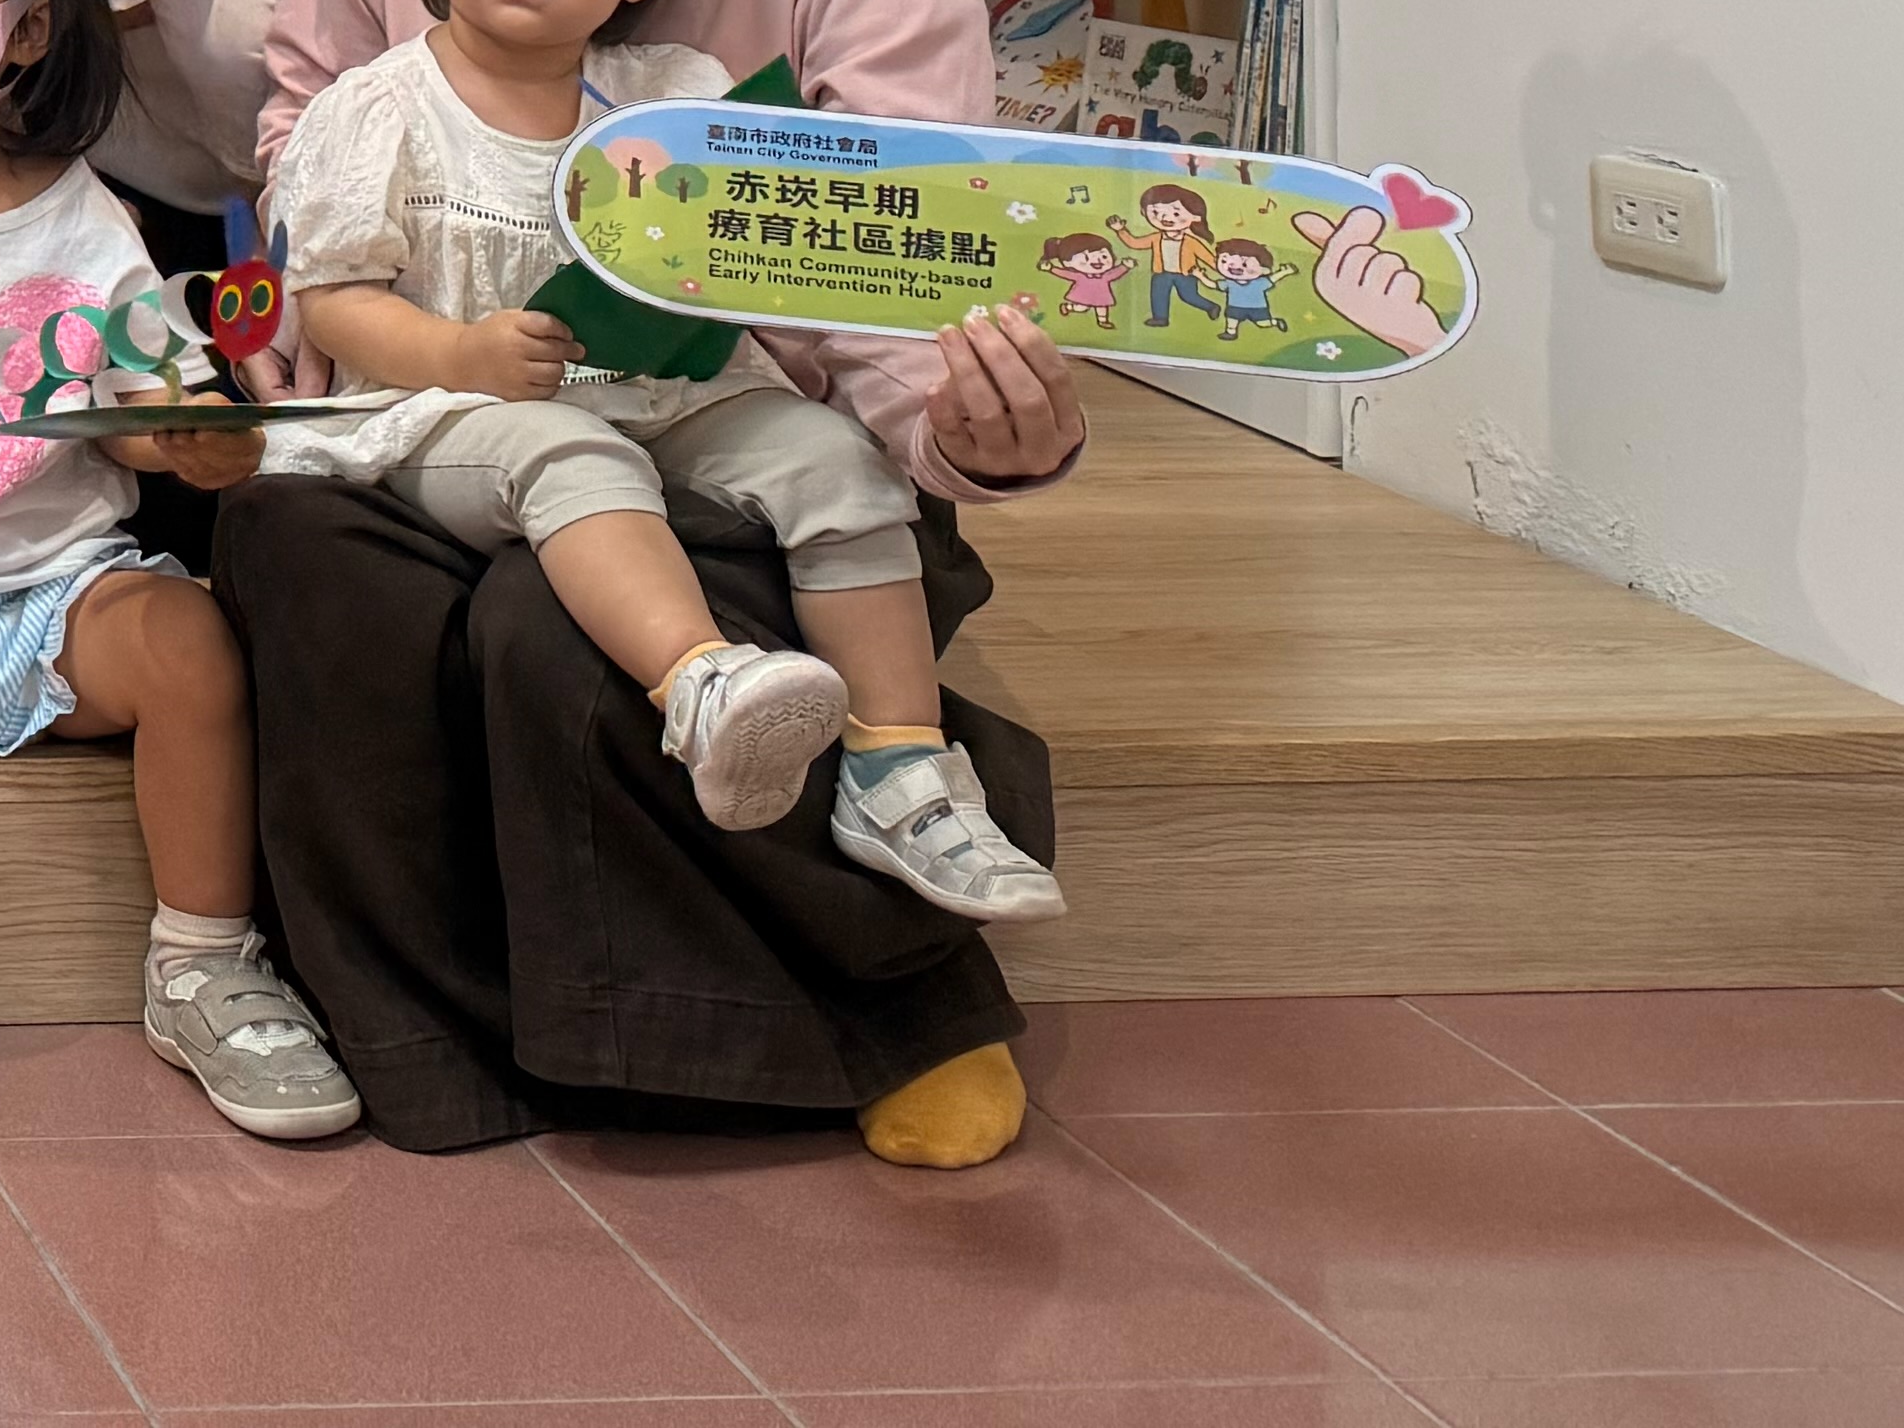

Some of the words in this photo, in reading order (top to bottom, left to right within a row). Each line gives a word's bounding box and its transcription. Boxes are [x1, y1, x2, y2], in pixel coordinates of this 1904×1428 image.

[706, 141, 753, 155] Tainan
[757, 147, 785, 160] City
[790, 150, 878, 168] Government
[707, 124, 878, 155] 臺南市政府社會局
[726, 170, 920, 219] 赤崁早期
[707, 208, 997, 267] 療育社區據點
[709, 248, 792, 269] Chihkan
[800, 257, 992, 290] Community-based
[709, 264, 760, 284] Early
[768, 266, 892, 295] Intervention
[899, 284, 942, 300] Hub
